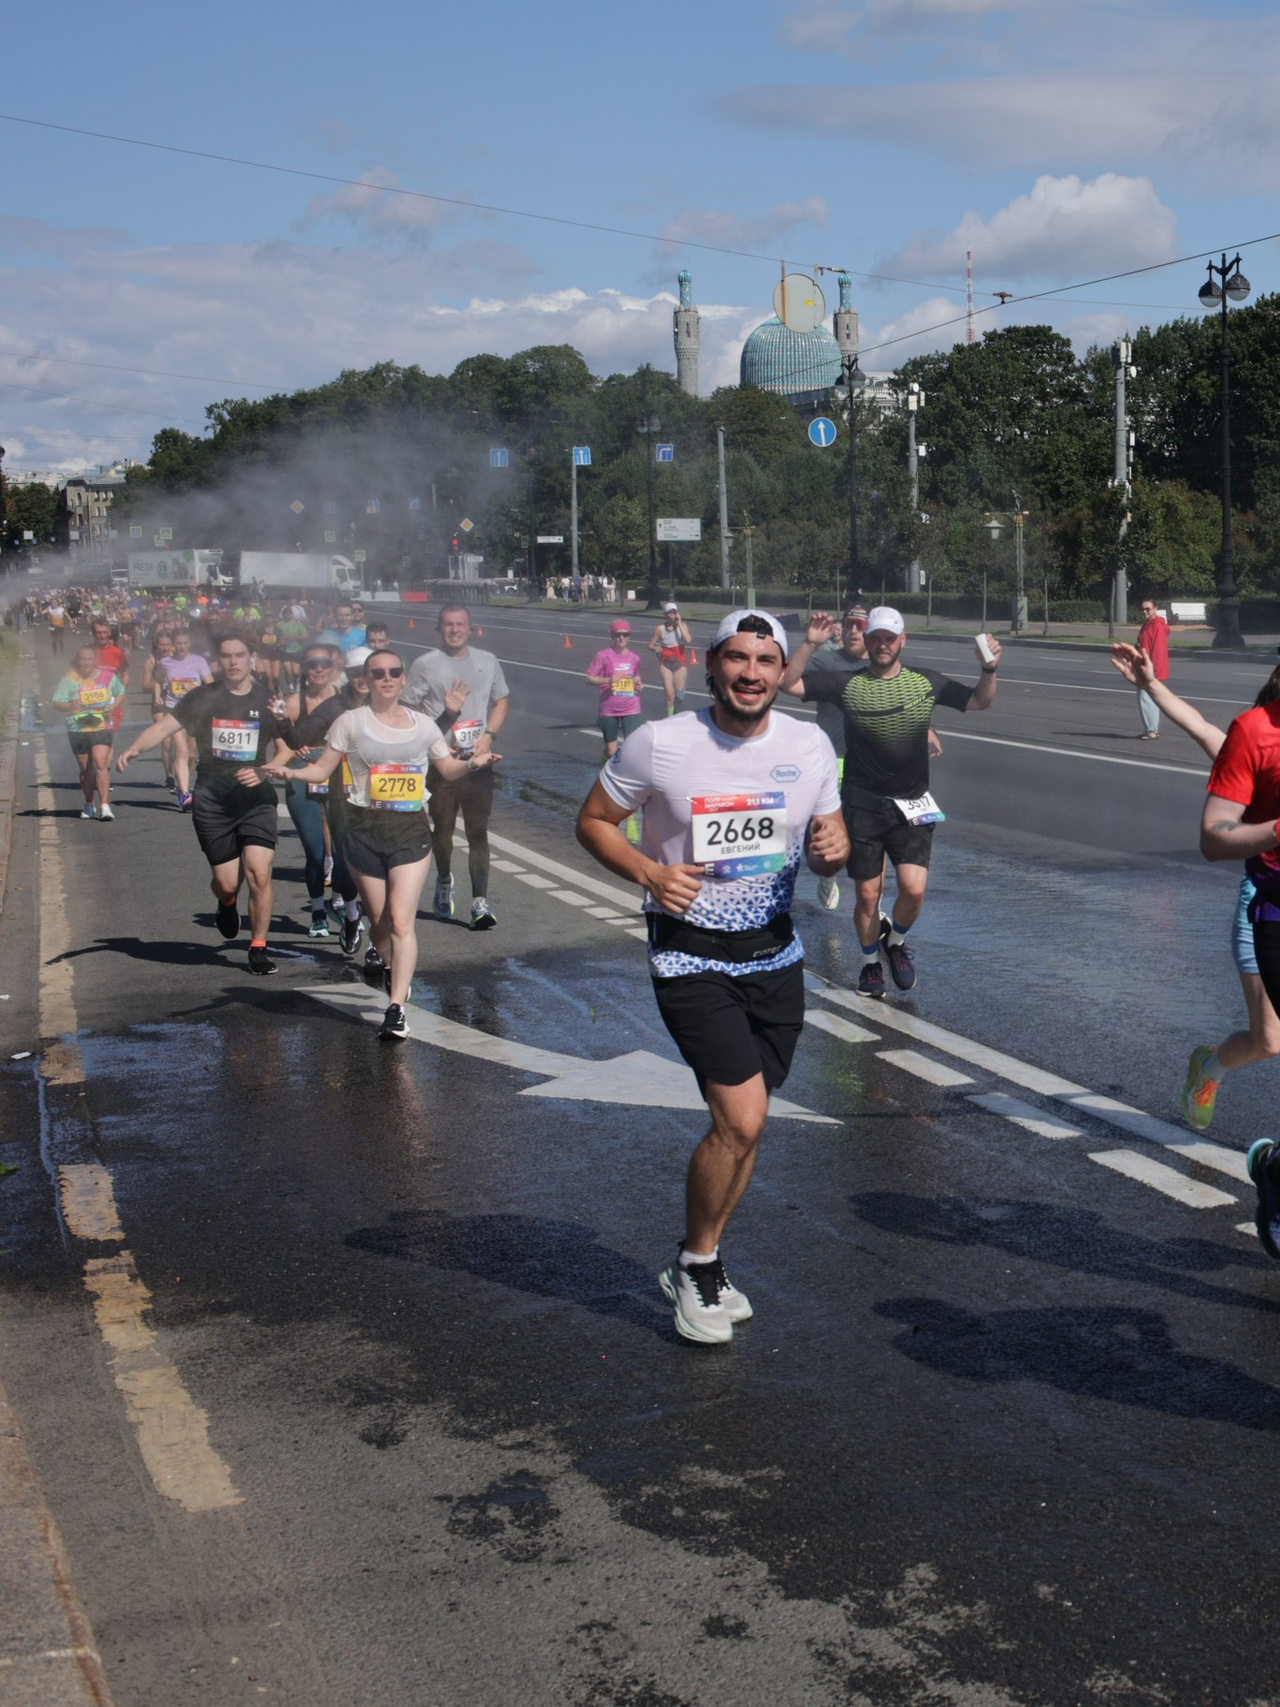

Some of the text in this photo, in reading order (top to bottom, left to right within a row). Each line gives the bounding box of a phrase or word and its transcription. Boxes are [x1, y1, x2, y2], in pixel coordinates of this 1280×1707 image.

[83, 691, 104, 701] 3986
[218, 731, 251, 745] 6811
[775, 769, 797, 777] Roche
[378, 777, 416, 792] 2778
[706, 817, 774, 846] 2668
[721, 842, 761, 854] ЕВГЕНИЙ
